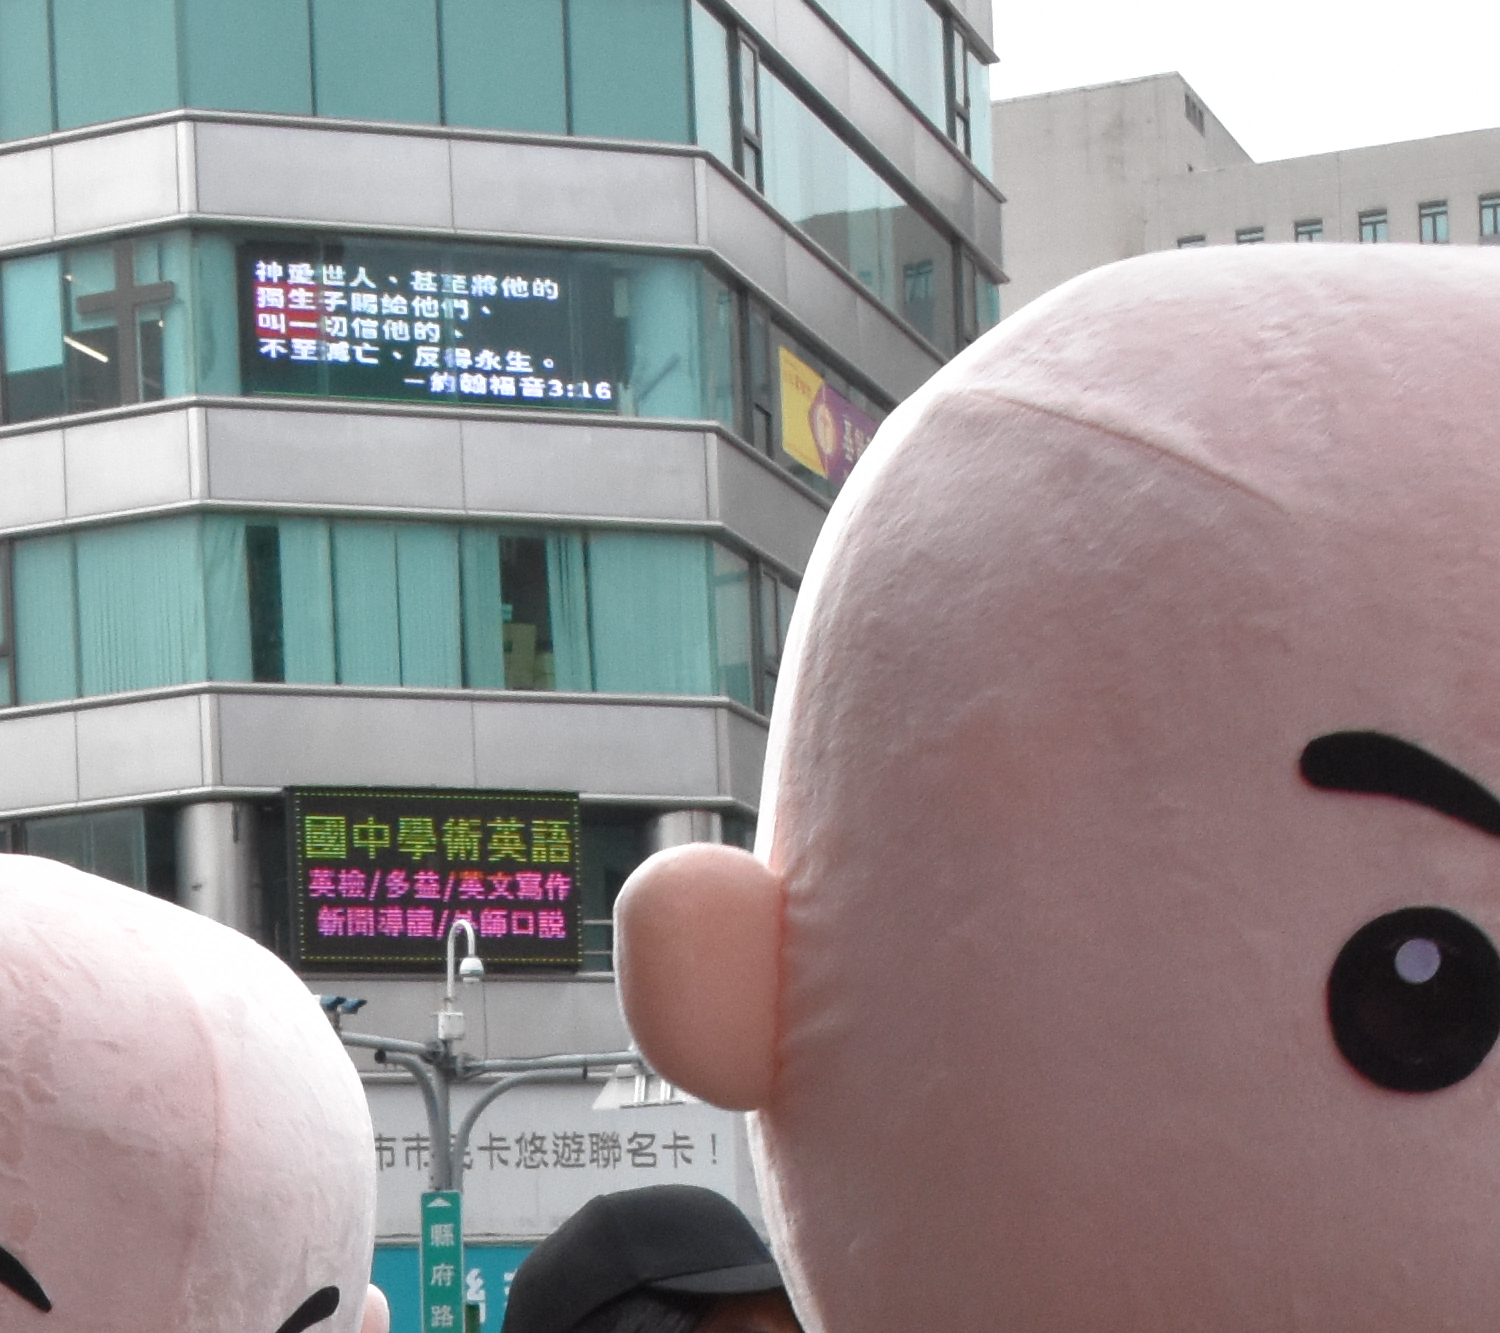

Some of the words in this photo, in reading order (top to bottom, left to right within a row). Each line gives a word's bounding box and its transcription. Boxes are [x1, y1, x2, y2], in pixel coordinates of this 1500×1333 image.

[304, 815, 572, 863] 國中學術英語
[308, 868, 573, 902] 英檢/多益/英文寫作
[430, 1223, 456, 1329] 縣府路
